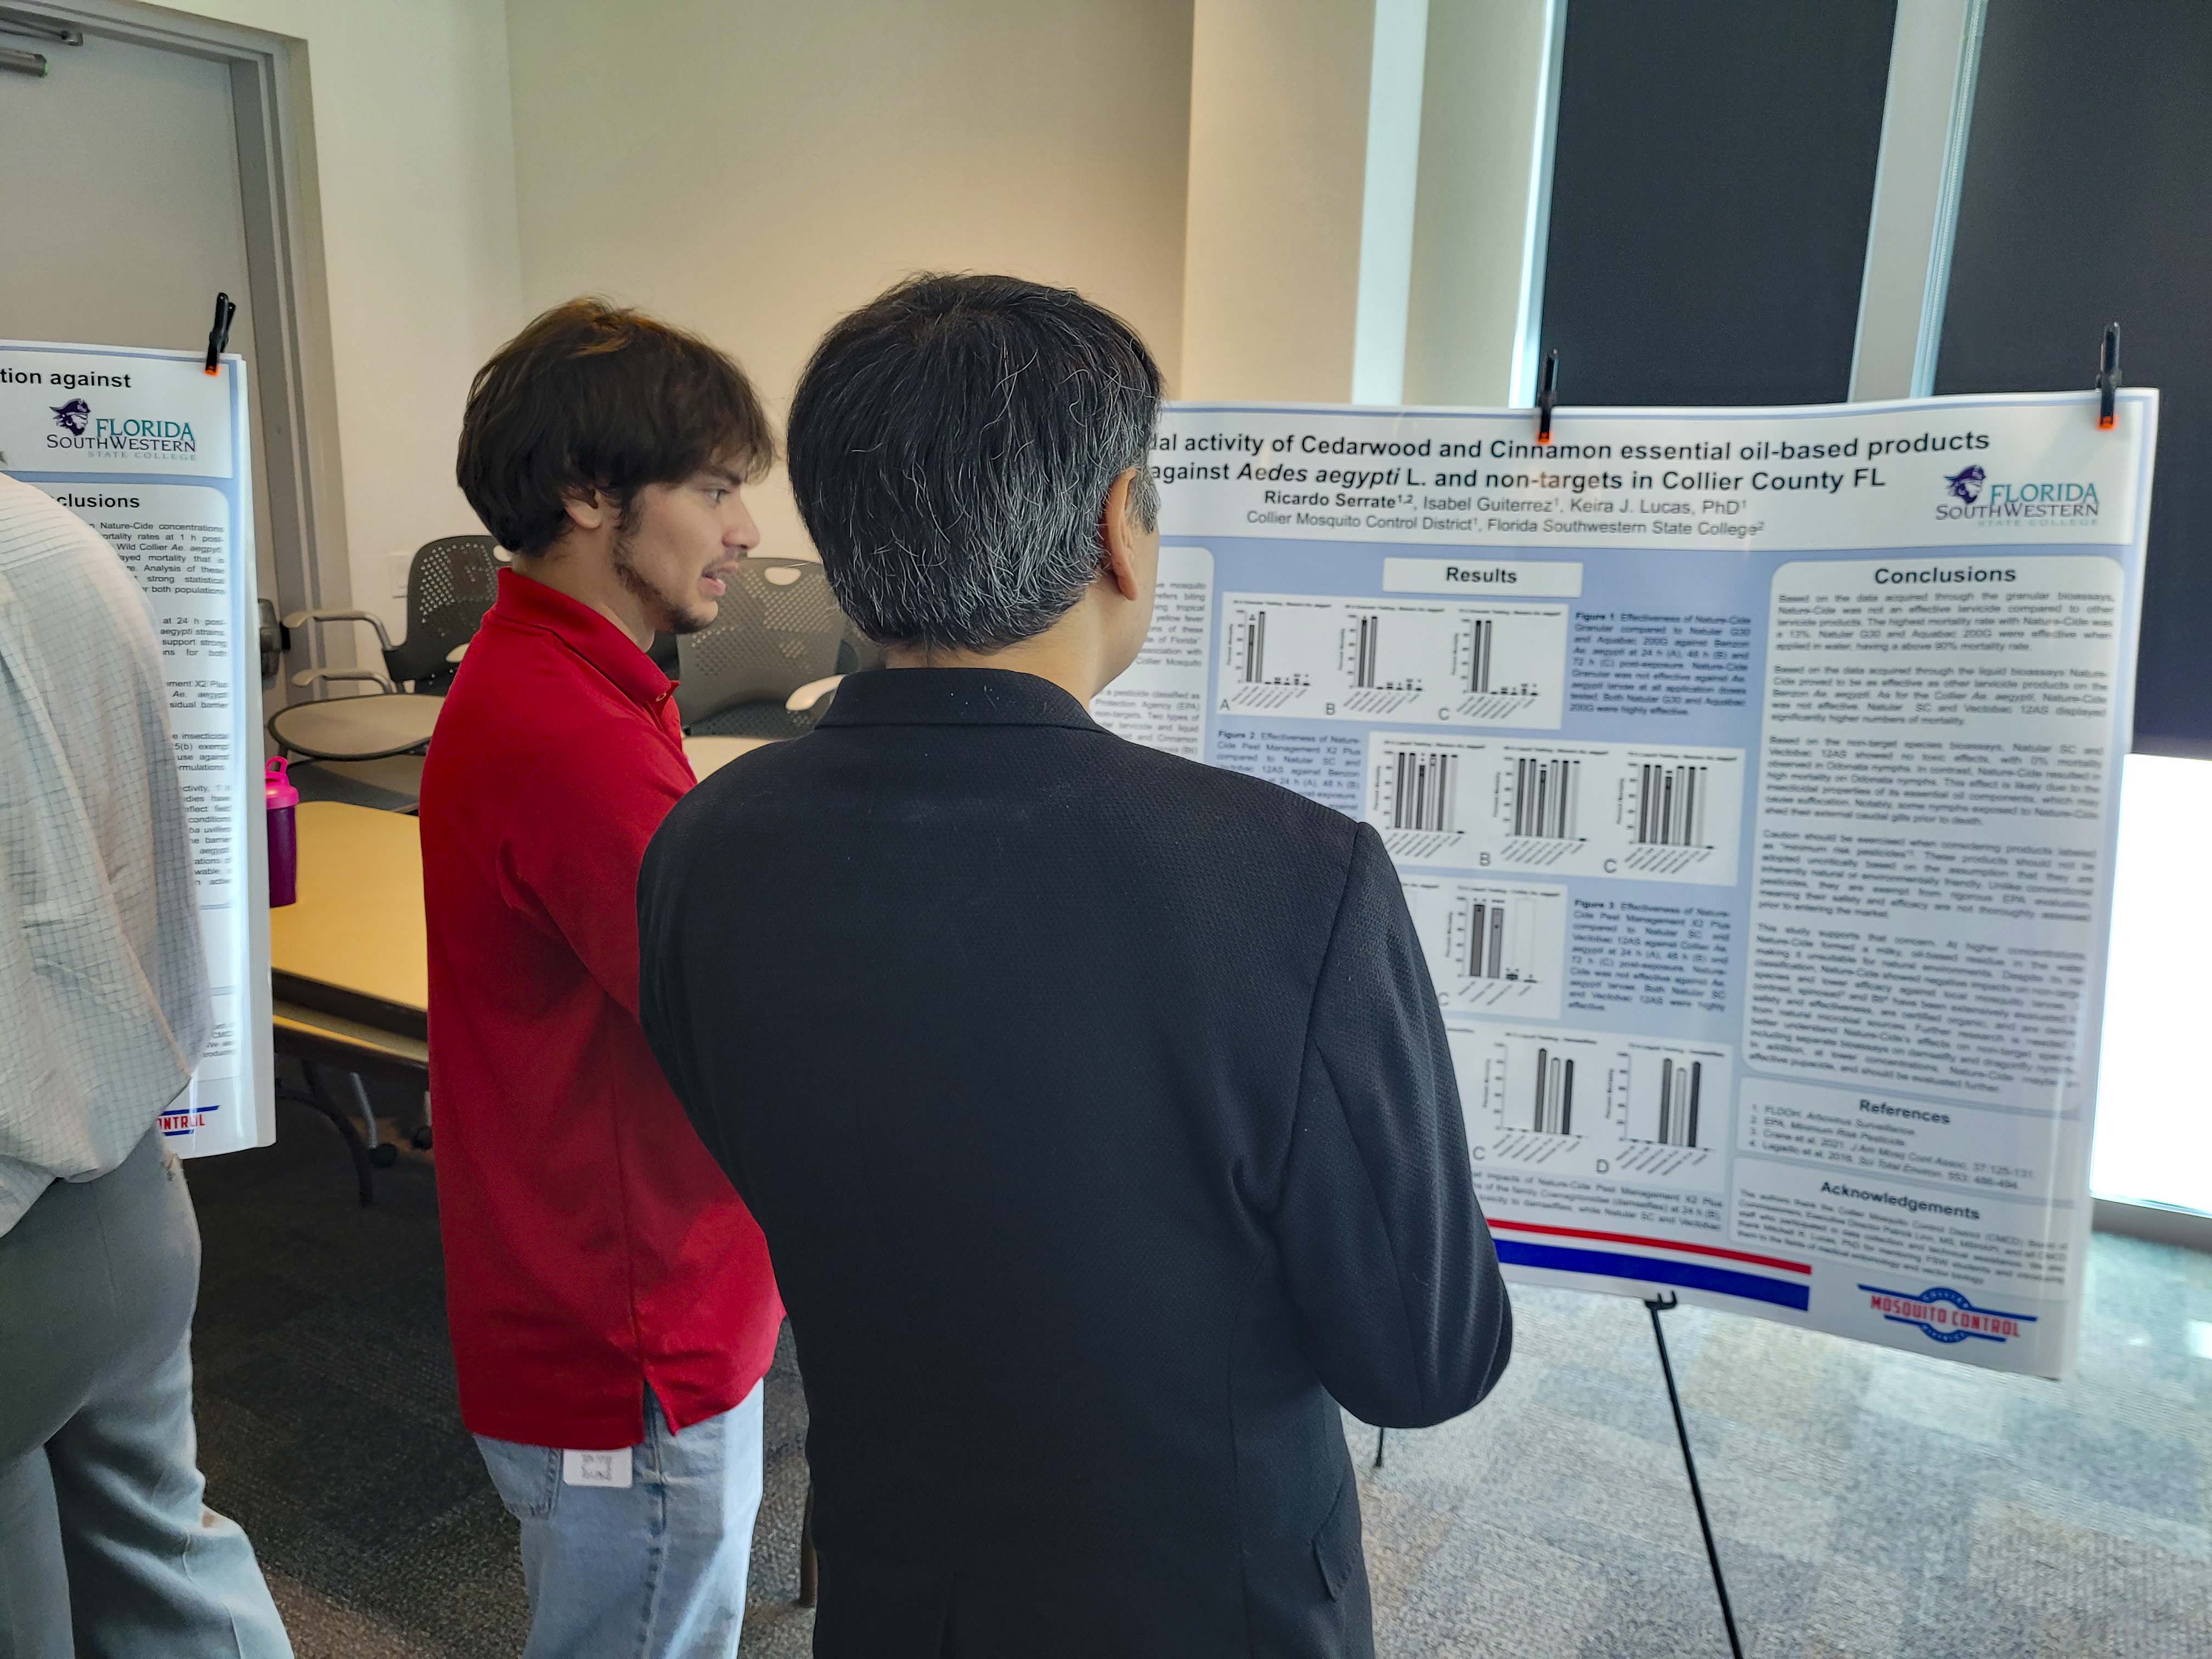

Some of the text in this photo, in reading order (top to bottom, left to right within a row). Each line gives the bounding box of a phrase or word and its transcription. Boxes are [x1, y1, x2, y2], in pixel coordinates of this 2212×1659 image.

[50, 372, 132, 390] against
[96, 419, 195, 439] FLORIDA
[47, 434, 196, 452] SOUTHWESTERN
[1185, 433, 1263, 456] activity
[1273, 435, 1295, 453] of
[1302, 436, 1431, 458] Cedarwood
[1440, 439, 1481, 458] and
[1491, 441, 1611, 460] Cinnamon
[1621, 441, 1730, 461] essential
[1741, 438, 1858, 461] oil-based
[1868, 431, 1990, 460] products
[134, 453, 198, 461] COLLEGE
[1152, 462, 1886, 493] against Aedes aegypti L. and non-targets in Collier County FL
[1990, 483, 2098, 504] FLORIDA
[1265, 491, 1329, 506] Ricardo
[1423, 496, 1471, 511] Isabel
[1570, 499, 1613, 514] Keira
[1620, 499, 1633, 514] J.
[1640, 499, 1695, 515] Lucas,
[1936, 503, 2098, 520] SOUTHWESTERN
[1247, 510, 1293, 524] Collier
[1296, 512, 1361, 528] Mosquito
[1366, 515, 1417, 529] Control
[1488, 518, 1537, 532] Florida
[1543, 520, 1646, 534] Southwestern
[1652, 521, 1692, 535] State
[144, 565, 181, 574] Analysis
[1446, 566, 1517, 584] Results
[1875, 566, 2016, 585] Conclusions
[1221, 699, 1230, 712] A
[1326, 703, 1335, 715] B
[1438, 708, 1450, 721] C
[1604, 859, 1617, 873] C
[1859, 1098, 1950, 1124] References
[1596, 1159, 1610, 1174] D
[1821, 1182, 1980, 1220] Acknowledgements
[1870, 1295, 1947, 1323] MOSQUITO
[1952, 1311, 2021, 1338] CONTROL
